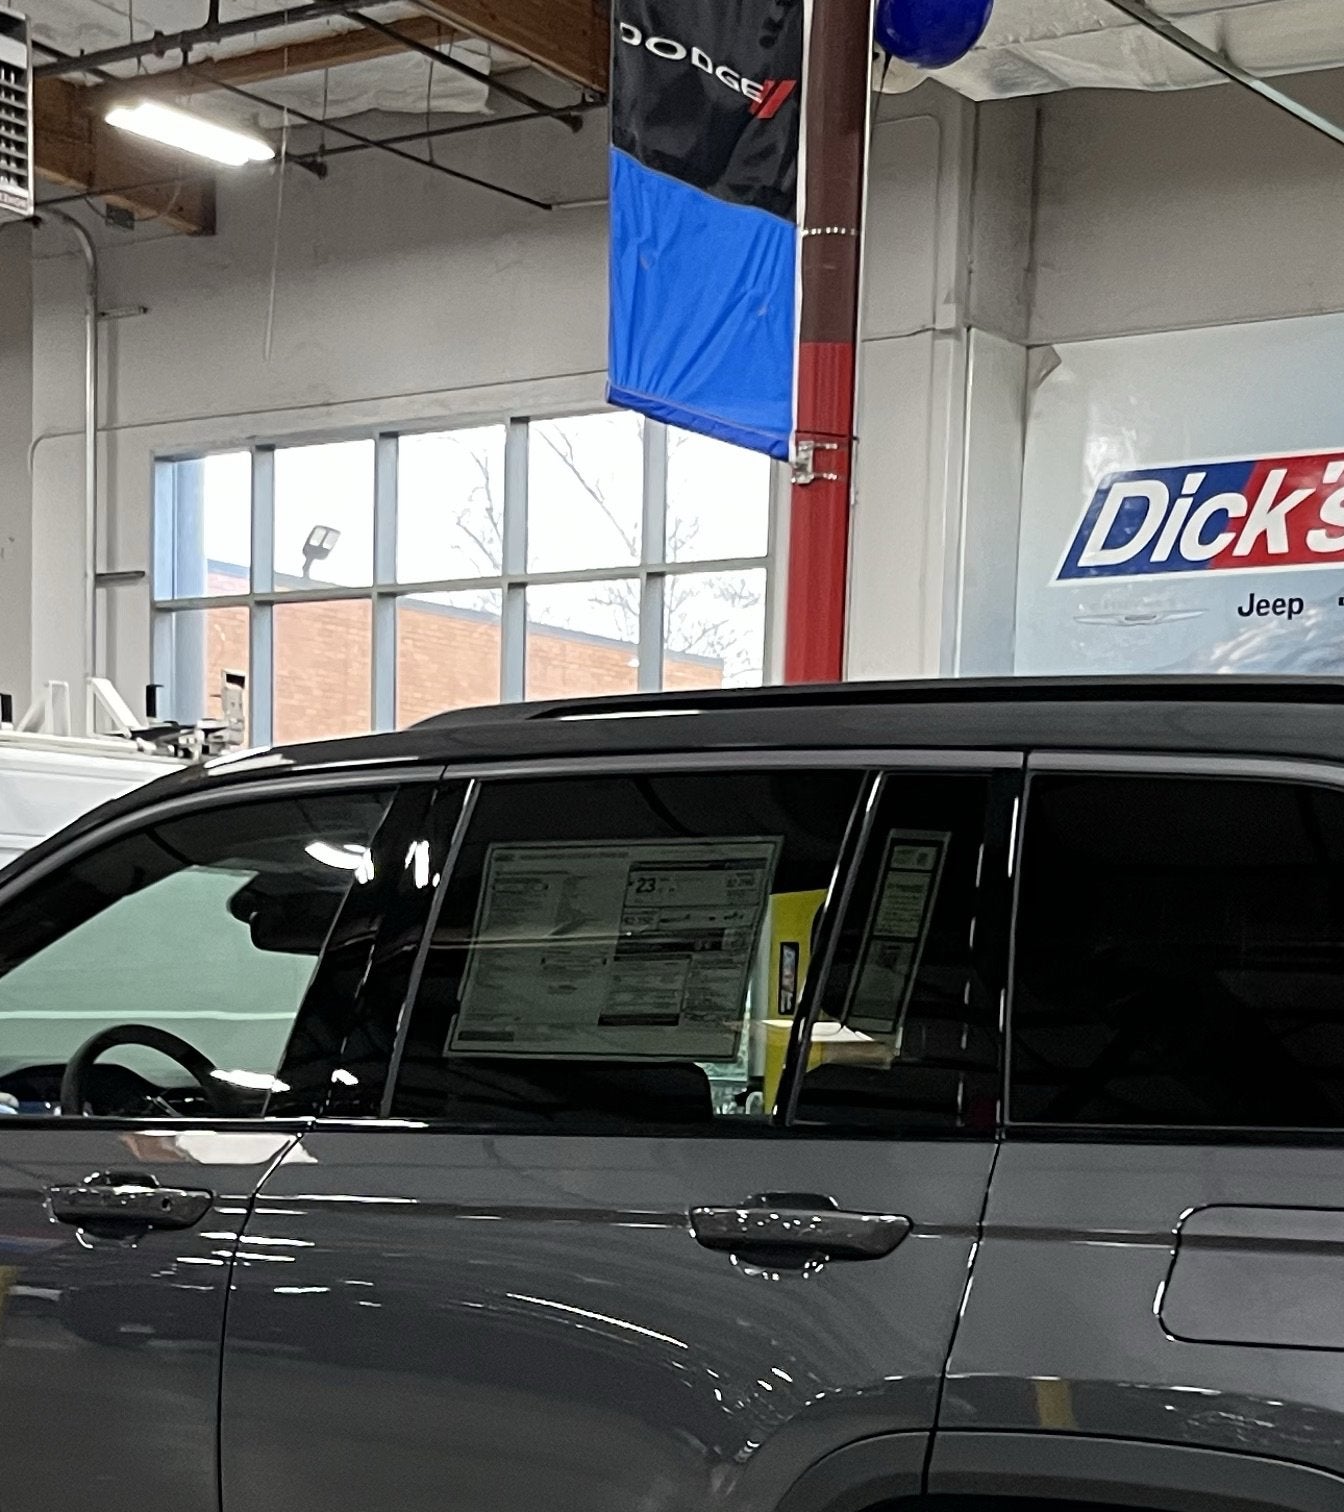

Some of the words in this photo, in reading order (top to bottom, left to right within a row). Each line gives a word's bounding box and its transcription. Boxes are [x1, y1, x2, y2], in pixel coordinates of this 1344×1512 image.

[619, 21, 764, 104] DODGE
[1237, 593, 1305, 620] Jeep
[634, 877, 657, 894] 23
